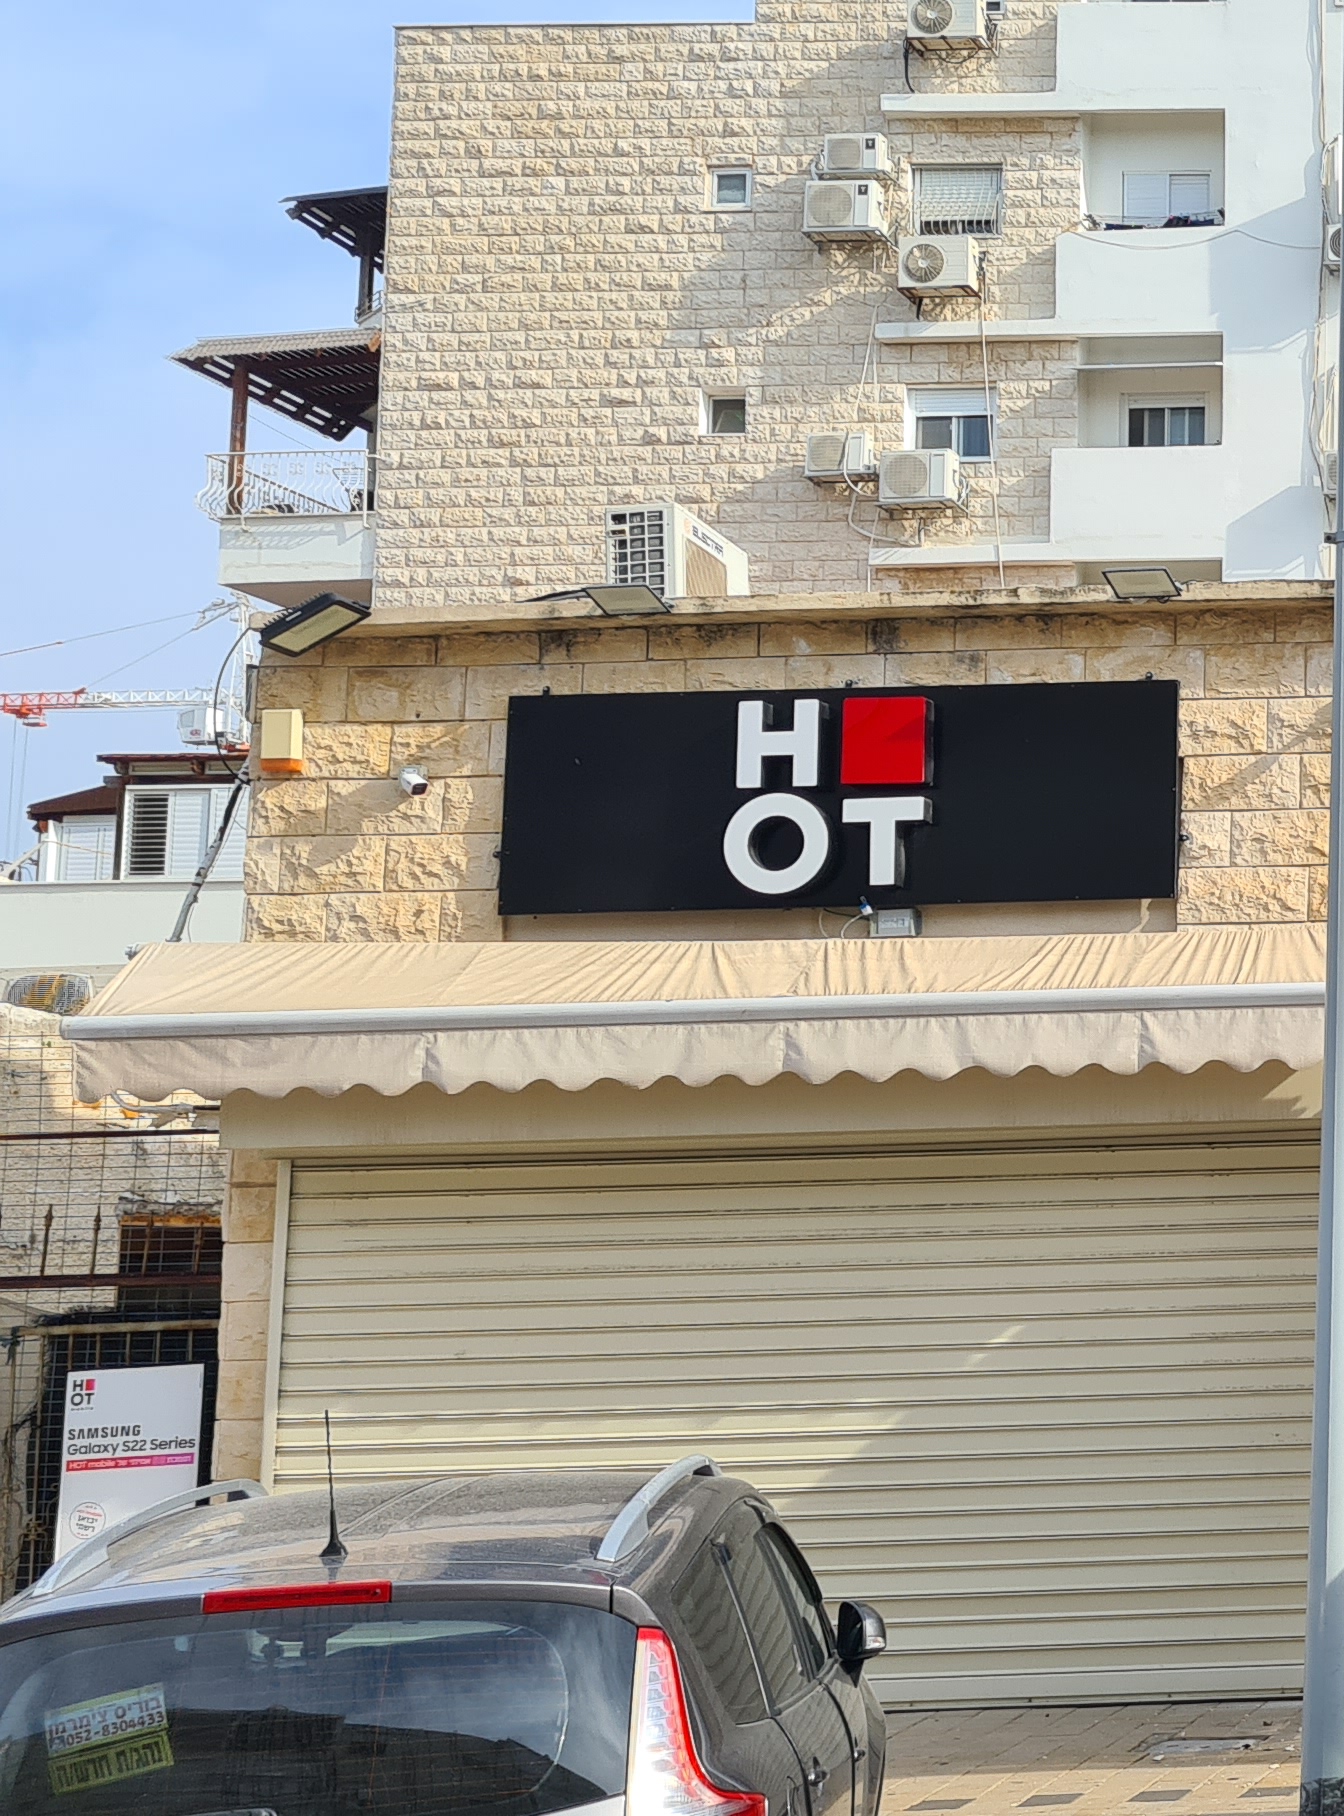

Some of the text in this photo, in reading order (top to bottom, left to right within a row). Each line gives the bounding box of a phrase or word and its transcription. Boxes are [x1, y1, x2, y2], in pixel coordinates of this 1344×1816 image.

[67, 1425, 142, 1441] SAMSUNG
[67, 1436, 196, 1456] Galaxy S22 Series
[115, 1697, 162, 1720] בוריס
[66, 1711, 165, 1746] 052-8304433
